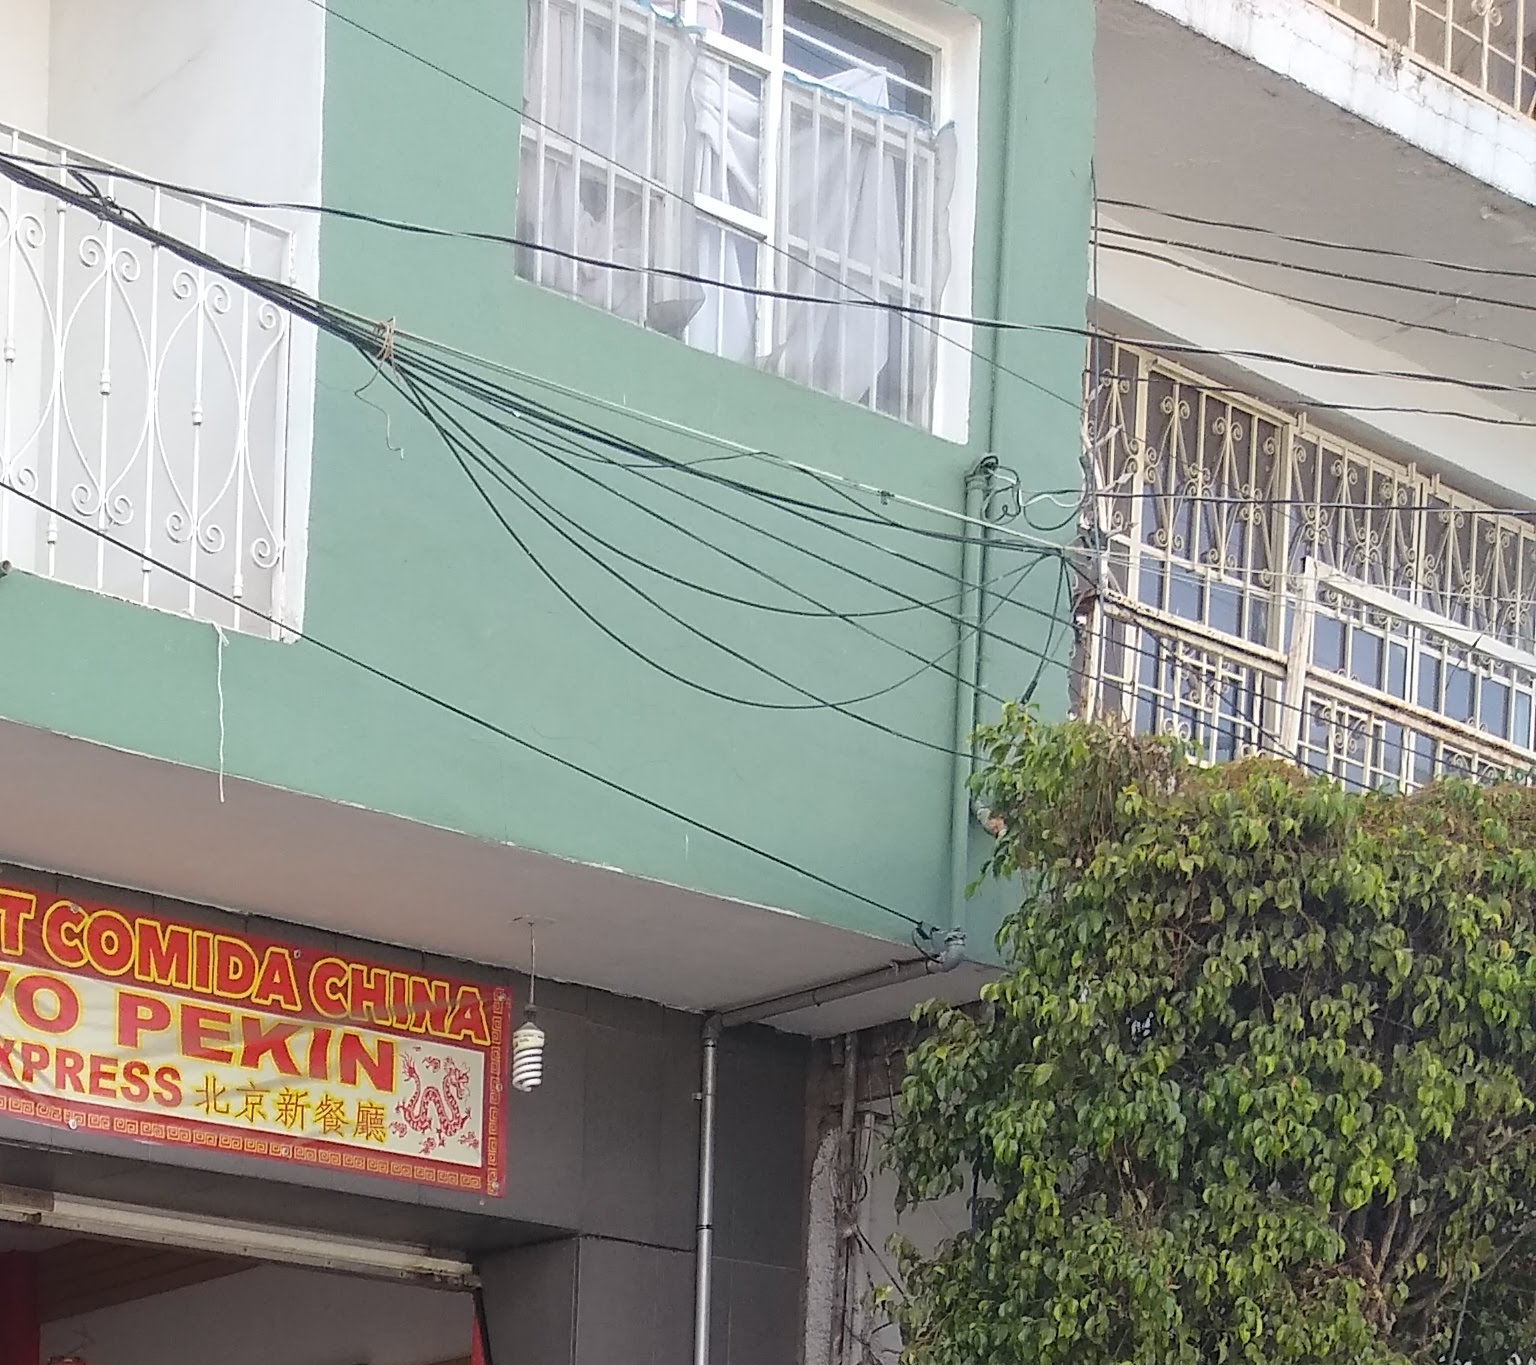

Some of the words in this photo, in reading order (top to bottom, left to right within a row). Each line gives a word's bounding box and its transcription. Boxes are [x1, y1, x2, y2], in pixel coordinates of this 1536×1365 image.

[40, 900, 299, 1008] COMIDA
[302, 957, 492, 1046] CHINA
[116, 989, 396, 1094] PEKIN
[195, 1073, 388, 1143] 北京新餐廳
